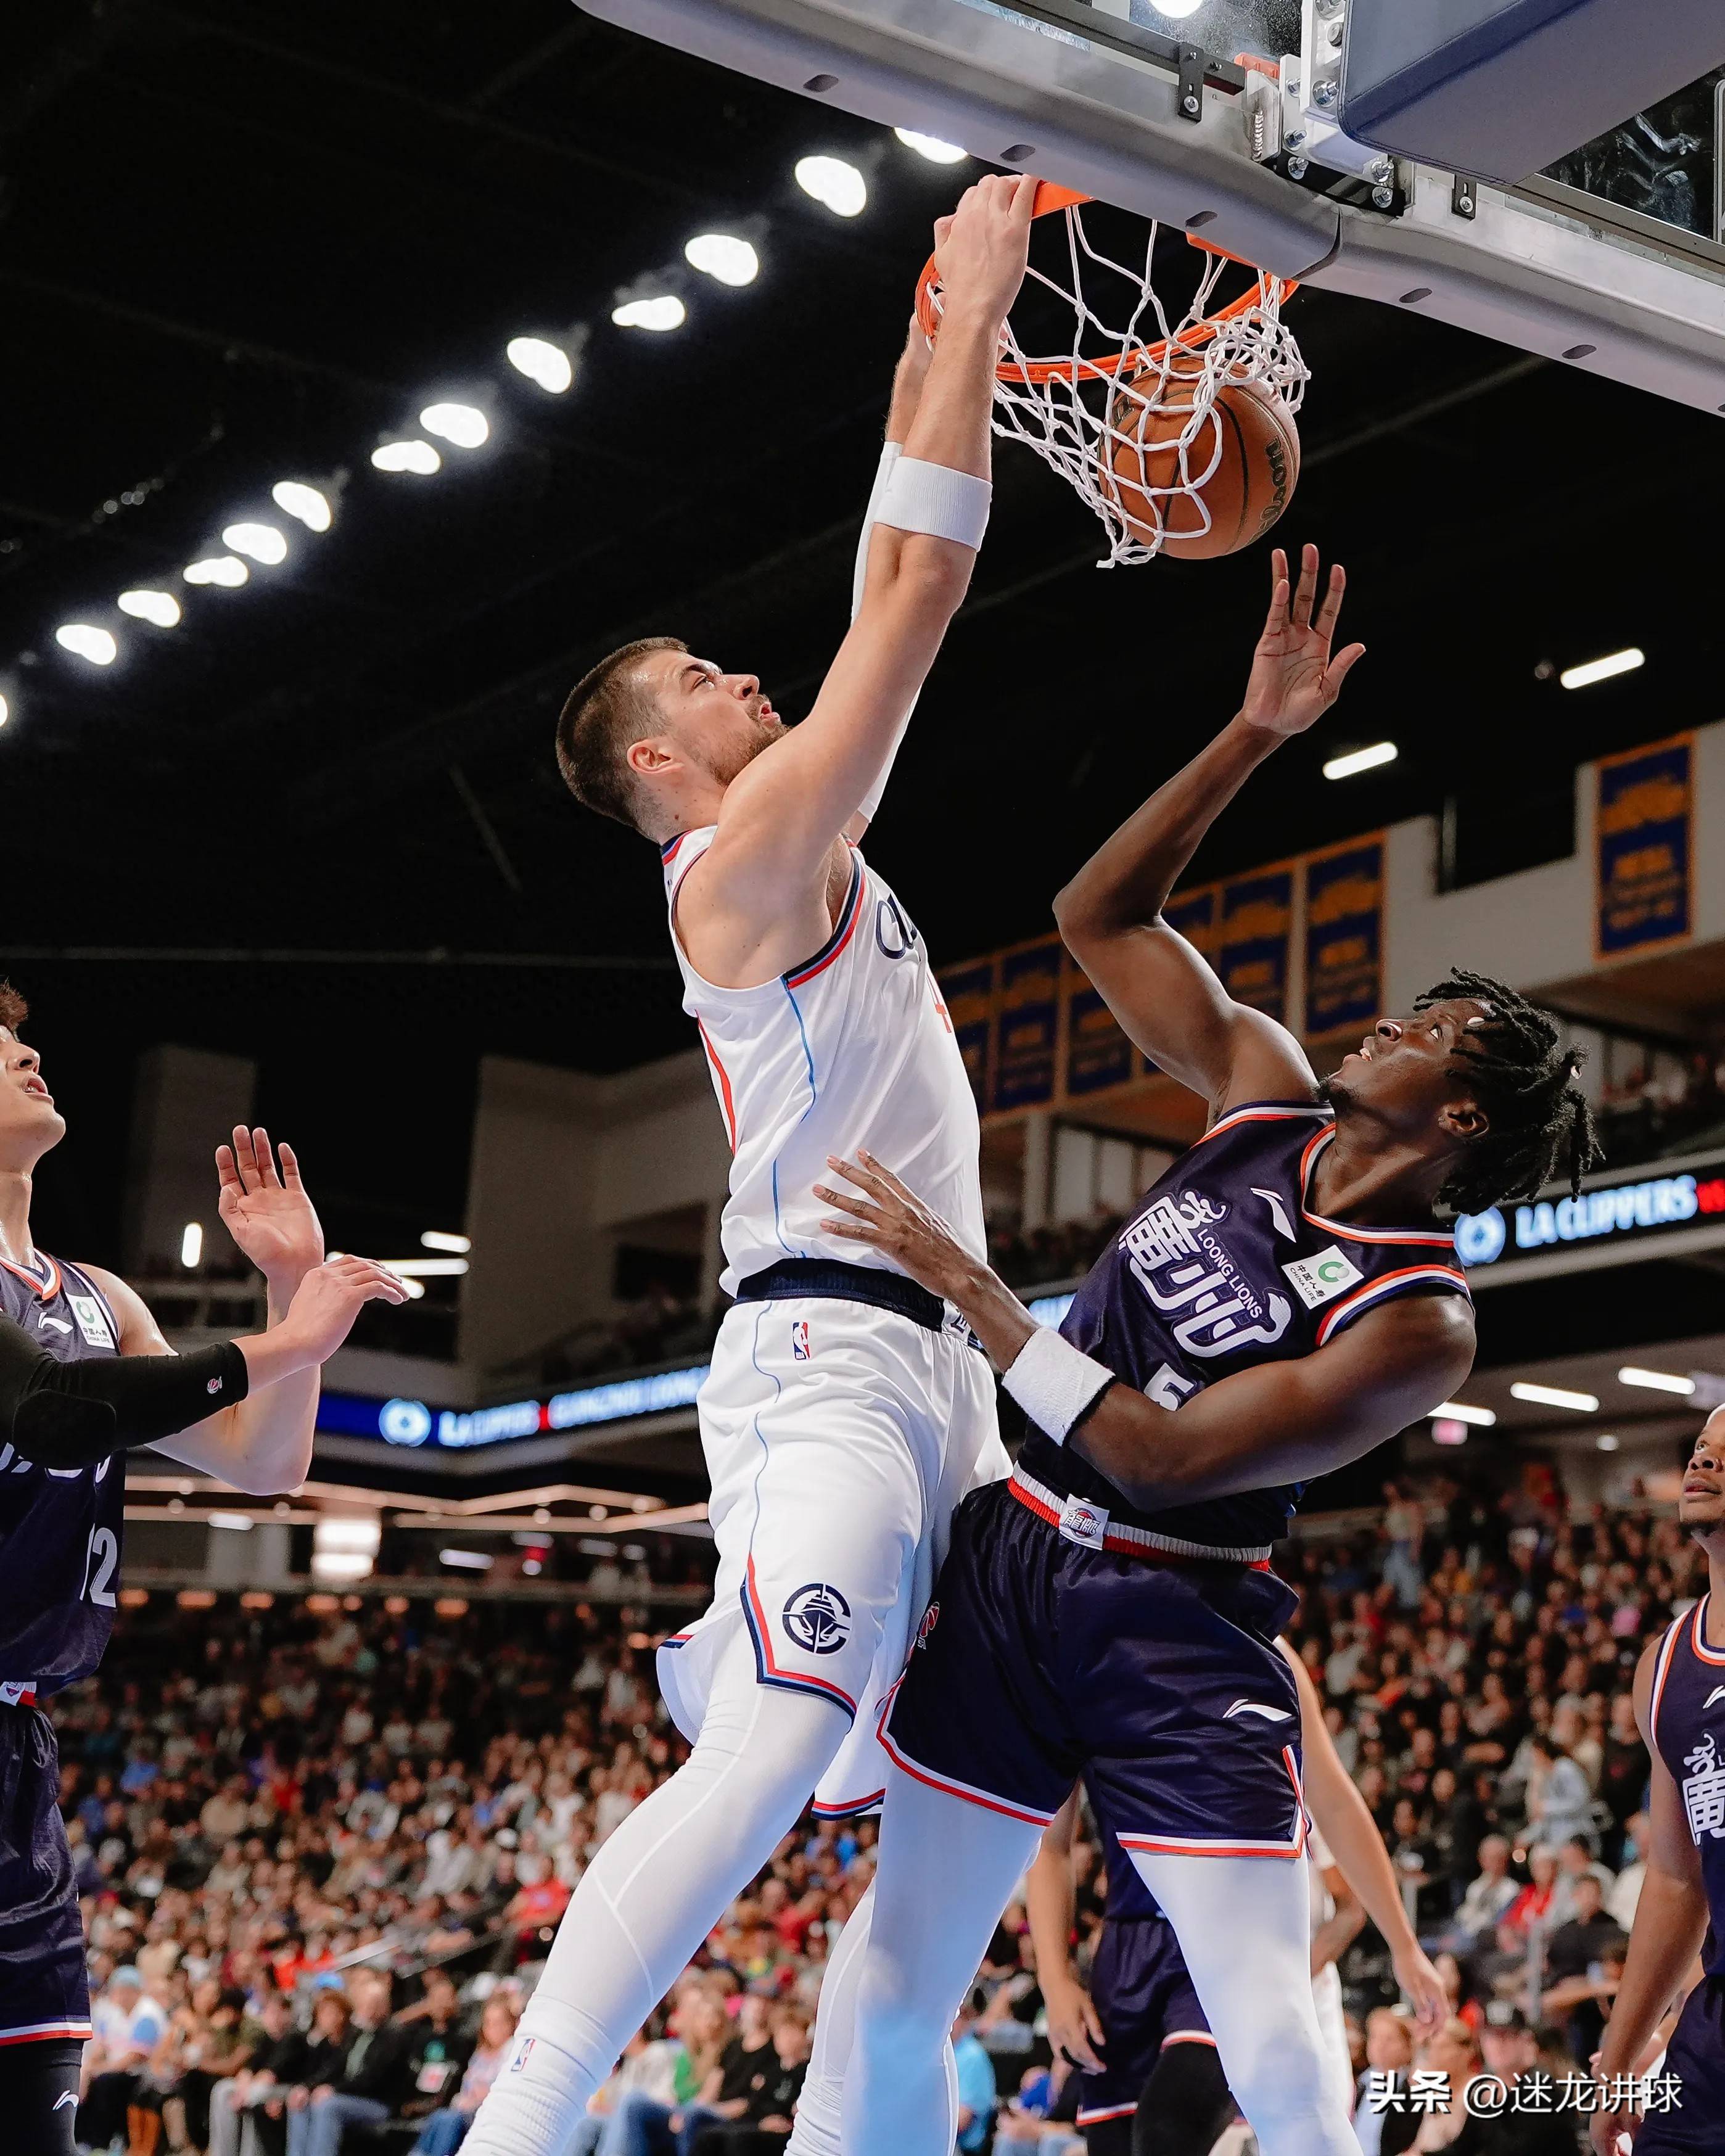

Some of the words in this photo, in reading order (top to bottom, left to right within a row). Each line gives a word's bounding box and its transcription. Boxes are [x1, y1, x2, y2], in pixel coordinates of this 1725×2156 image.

[1197, 1229, 1233, 1277] LOONG
[1229, 1275, 1262, 1319] LIONS
[1290, 1267, 1304, 1286] CHINA
[1304, 1287, 1317, 1302] LIFE
